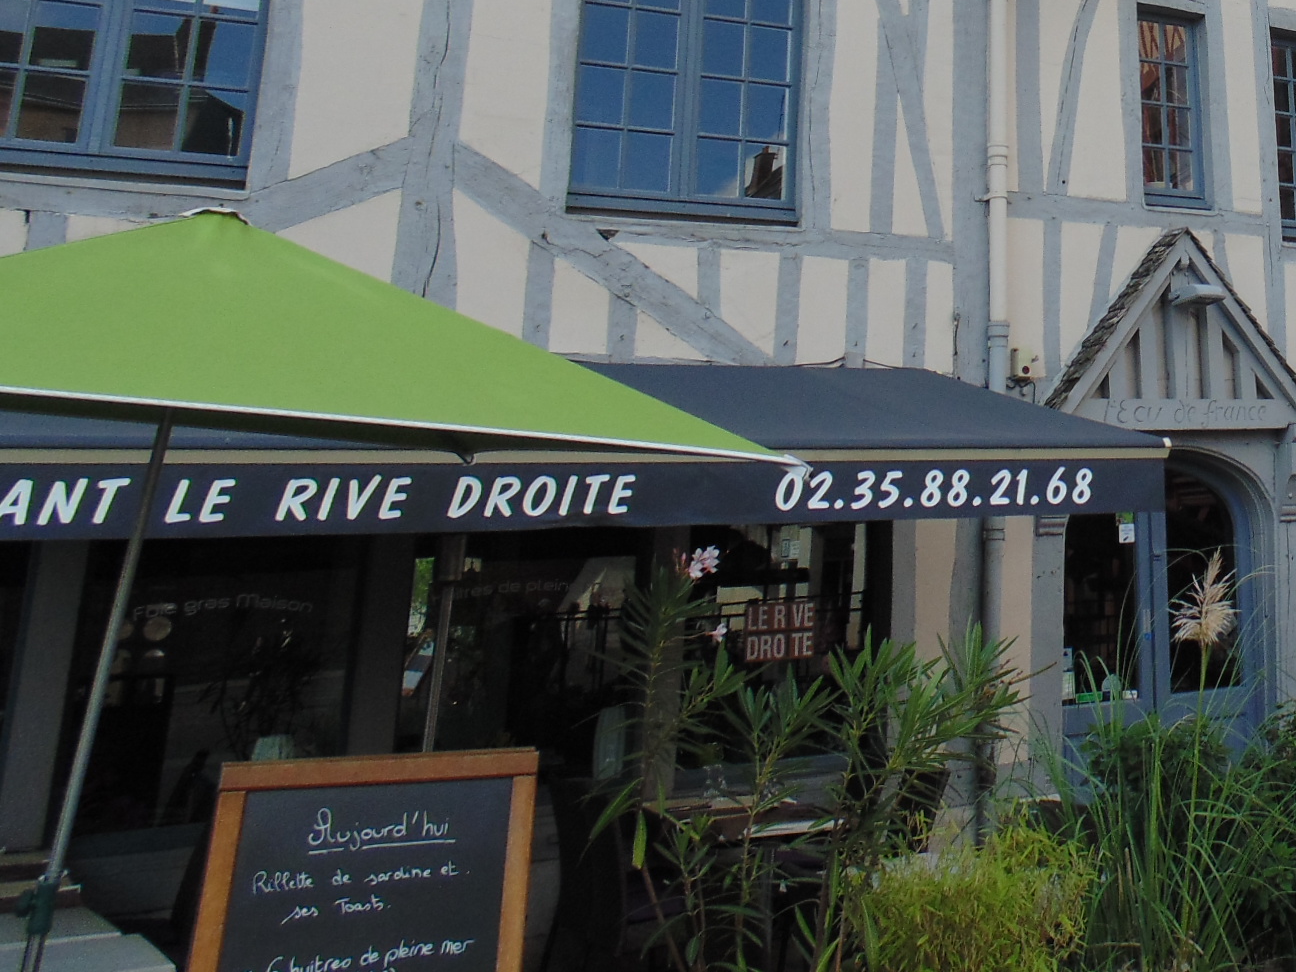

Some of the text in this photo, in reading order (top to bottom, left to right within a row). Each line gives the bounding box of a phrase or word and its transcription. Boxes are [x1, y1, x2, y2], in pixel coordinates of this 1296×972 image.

[164, 478, 236, 524] LE
[274, 474, 413, 521] RIVE
[447, 474, 636, 520] DROITE
[775, 466, 1093, 511] 02.35.88.21.68
[183, 596, 231, 617] gras
[748, 606, 769, 630] LE
[308, 807, 449, 851] Aujourd'hui
[332, 868, 352, 886] de
[364, 865, 432, 885] sardine
[281, 904, 319, 925] ses
[360, 944, 380, 966] de
[384, 937, 435, 967] pleine
